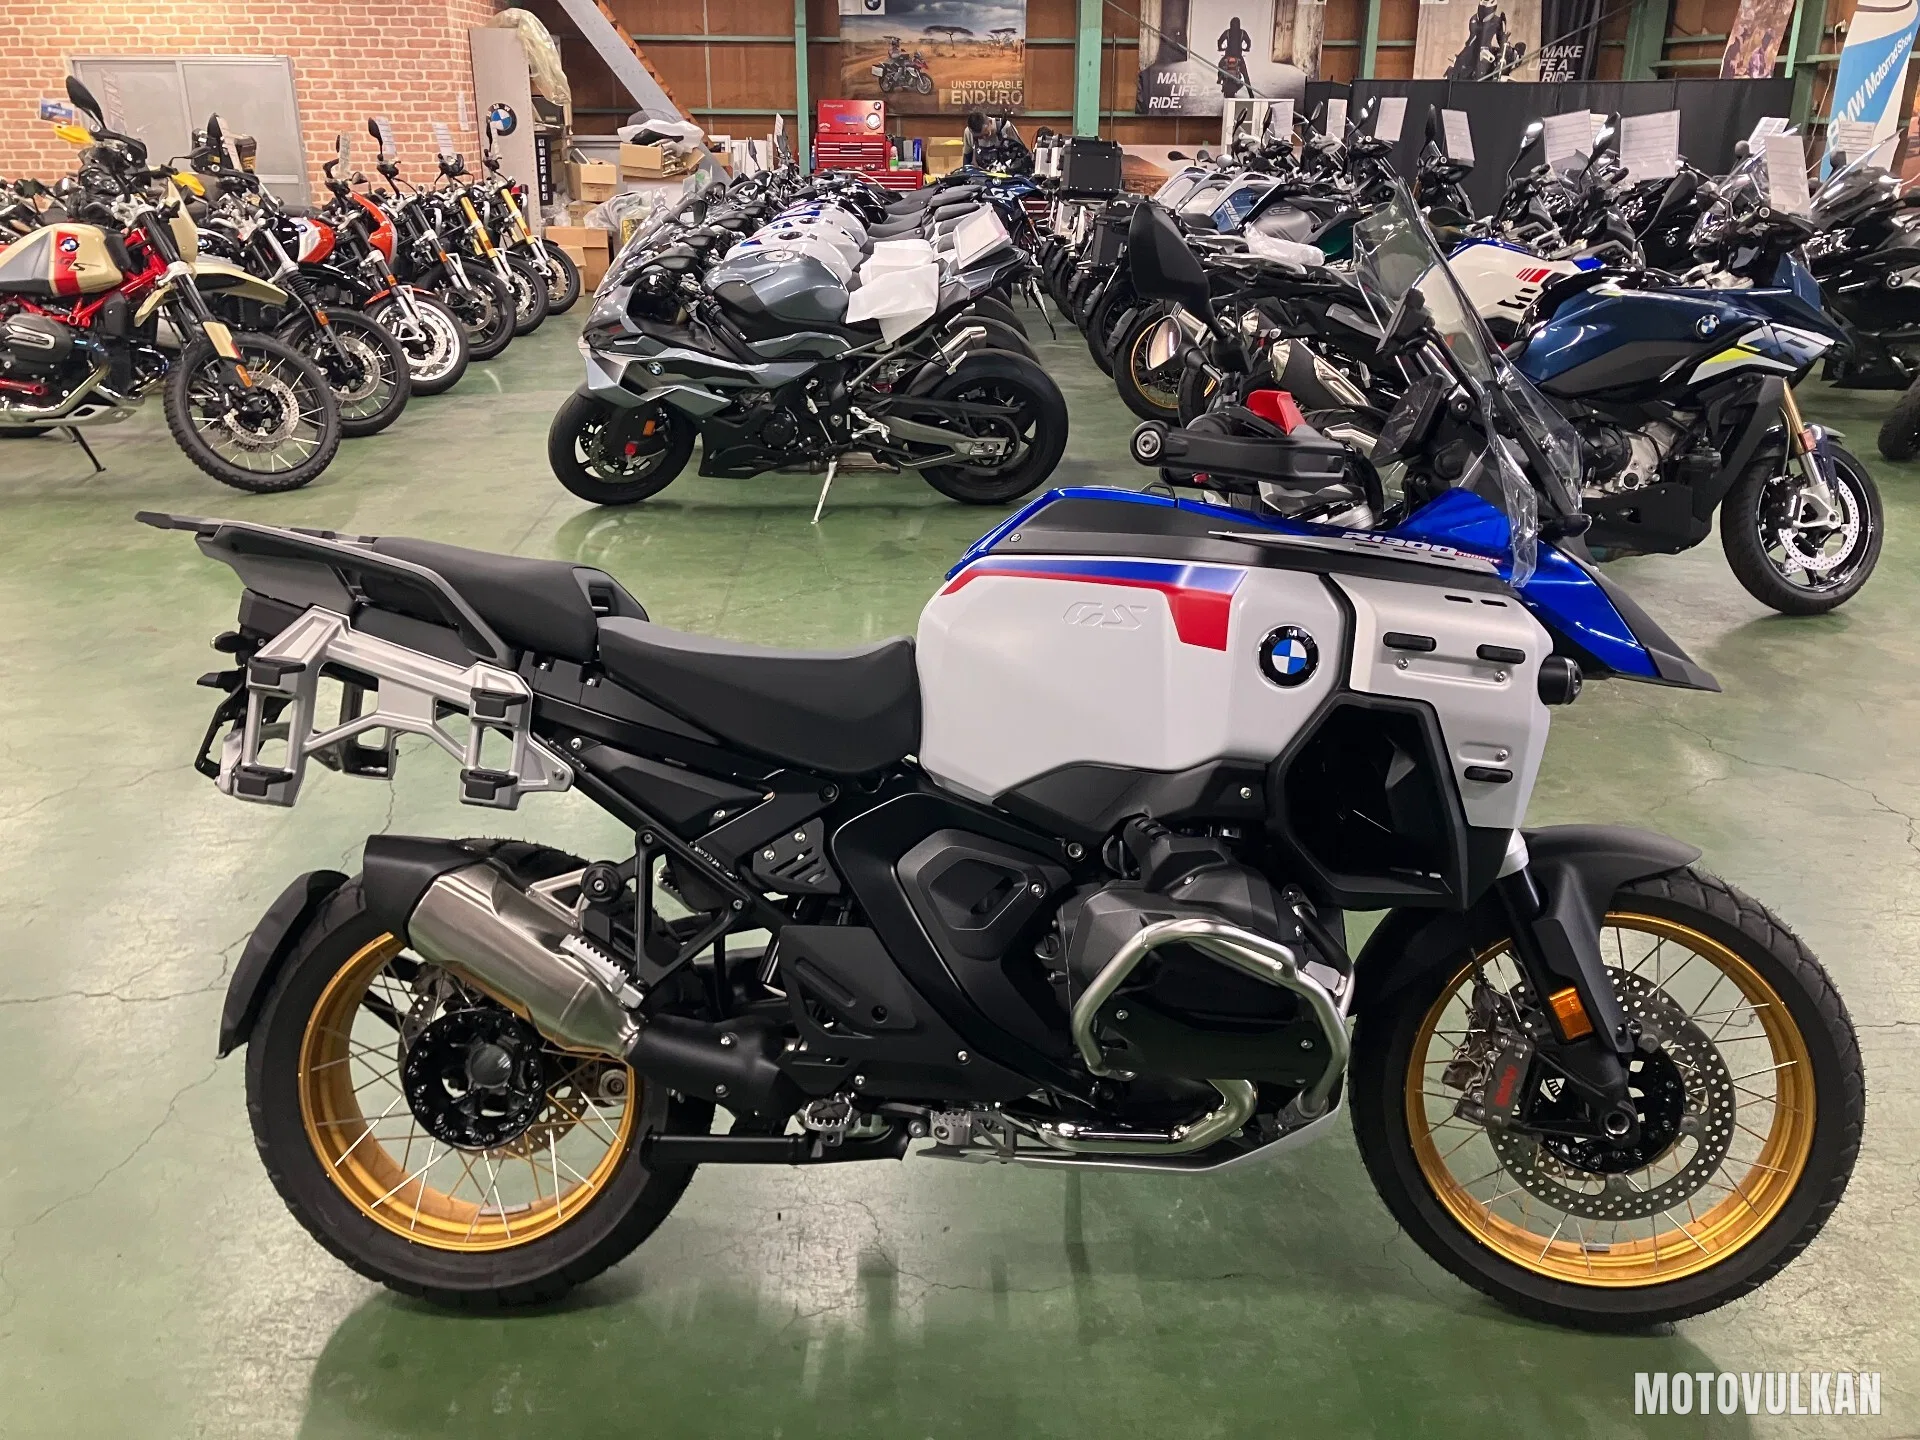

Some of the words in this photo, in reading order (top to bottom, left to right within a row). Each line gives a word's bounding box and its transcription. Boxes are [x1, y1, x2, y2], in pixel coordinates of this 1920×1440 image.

[1542, 45, 1584, 58] MAKE
[1557, 58, 1568, 71] A
[1865, 44, 1898, 99] Motorrad
[1897, 32, 1912, 53] Show
[951, 80, 1023, 89] UNSTOPPABLE
[1157, 72, 1197, 84] MAKE
[951, 90, 1023, 105] ENDURO
[1170, 85, 1197, 97] LIFE
[1149, 96, 1182, 109] RIDE.
[1062, 601, 1148, 631] GS
